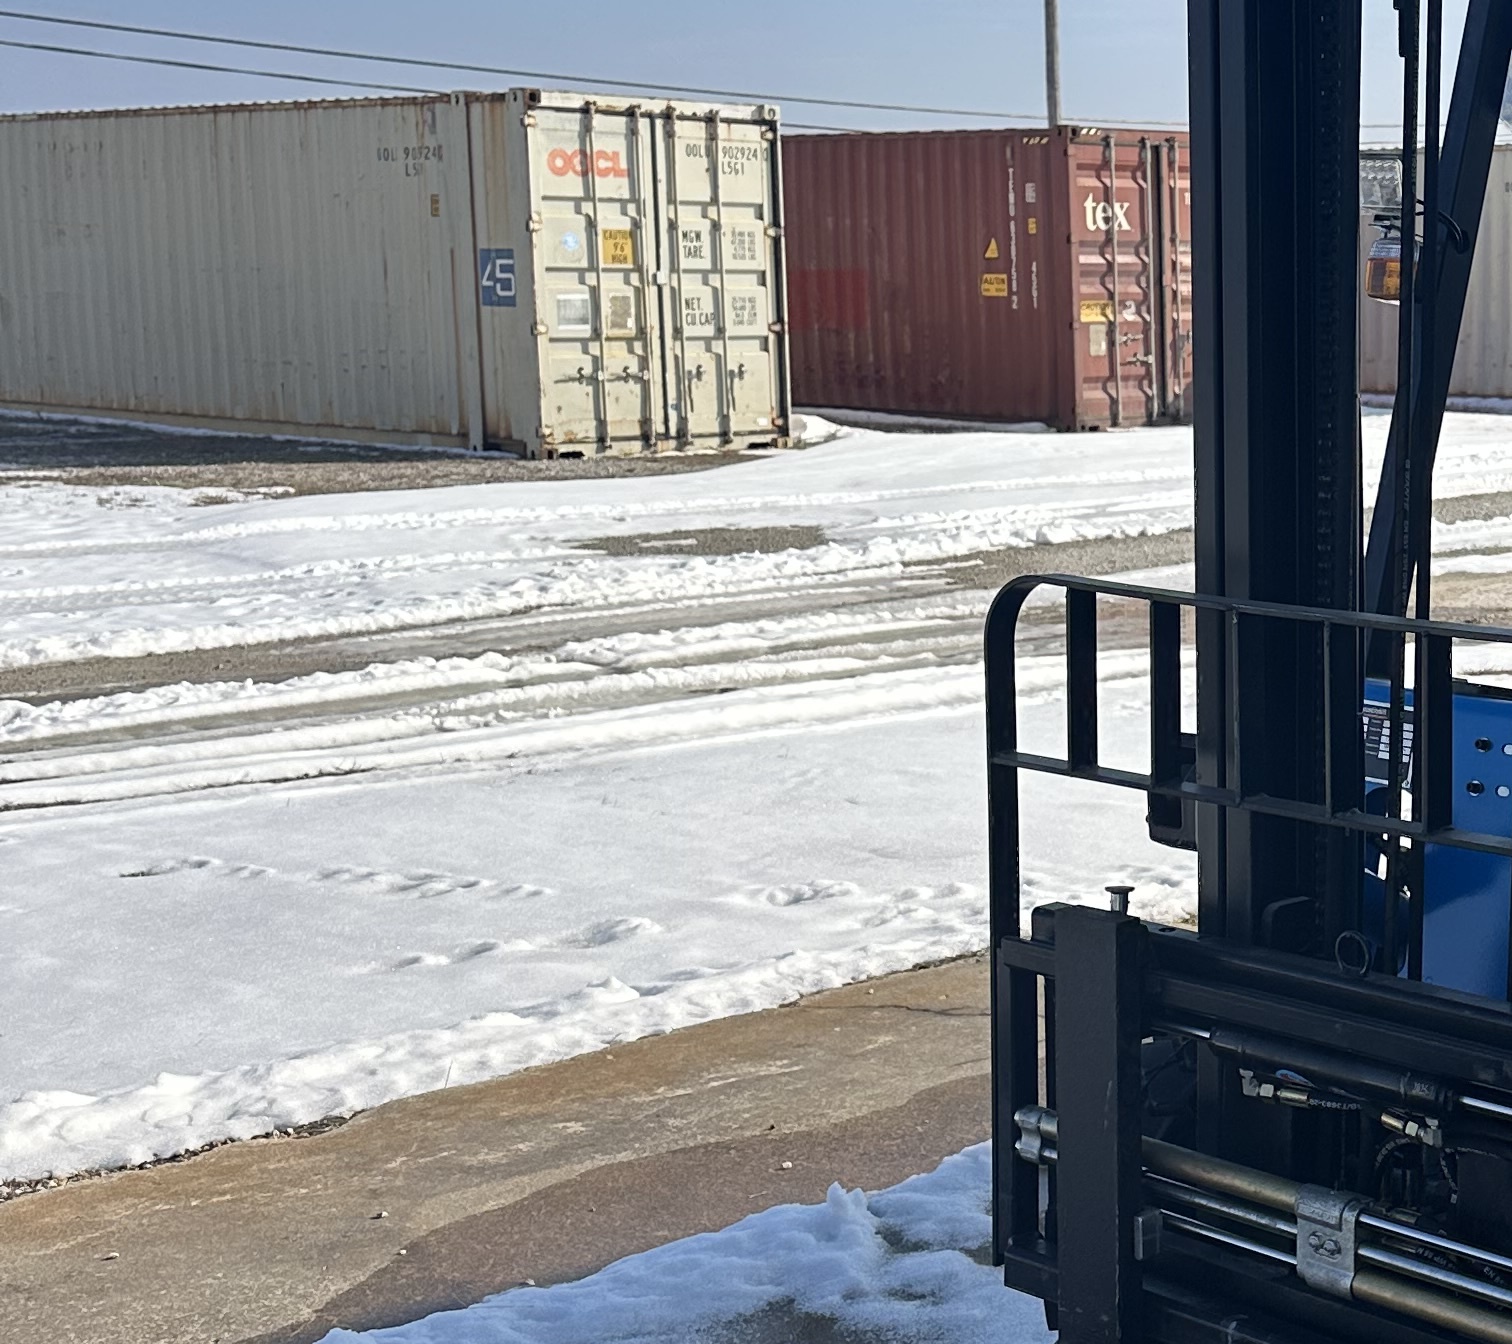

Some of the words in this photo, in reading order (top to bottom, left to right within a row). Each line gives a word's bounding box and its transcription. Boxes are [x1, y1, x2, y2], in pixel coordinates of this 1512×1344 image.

[547, 149, 630, 178] OOCL
[1083, 192, 1132, 232] tex
[481, 258, 516, 297] 45
